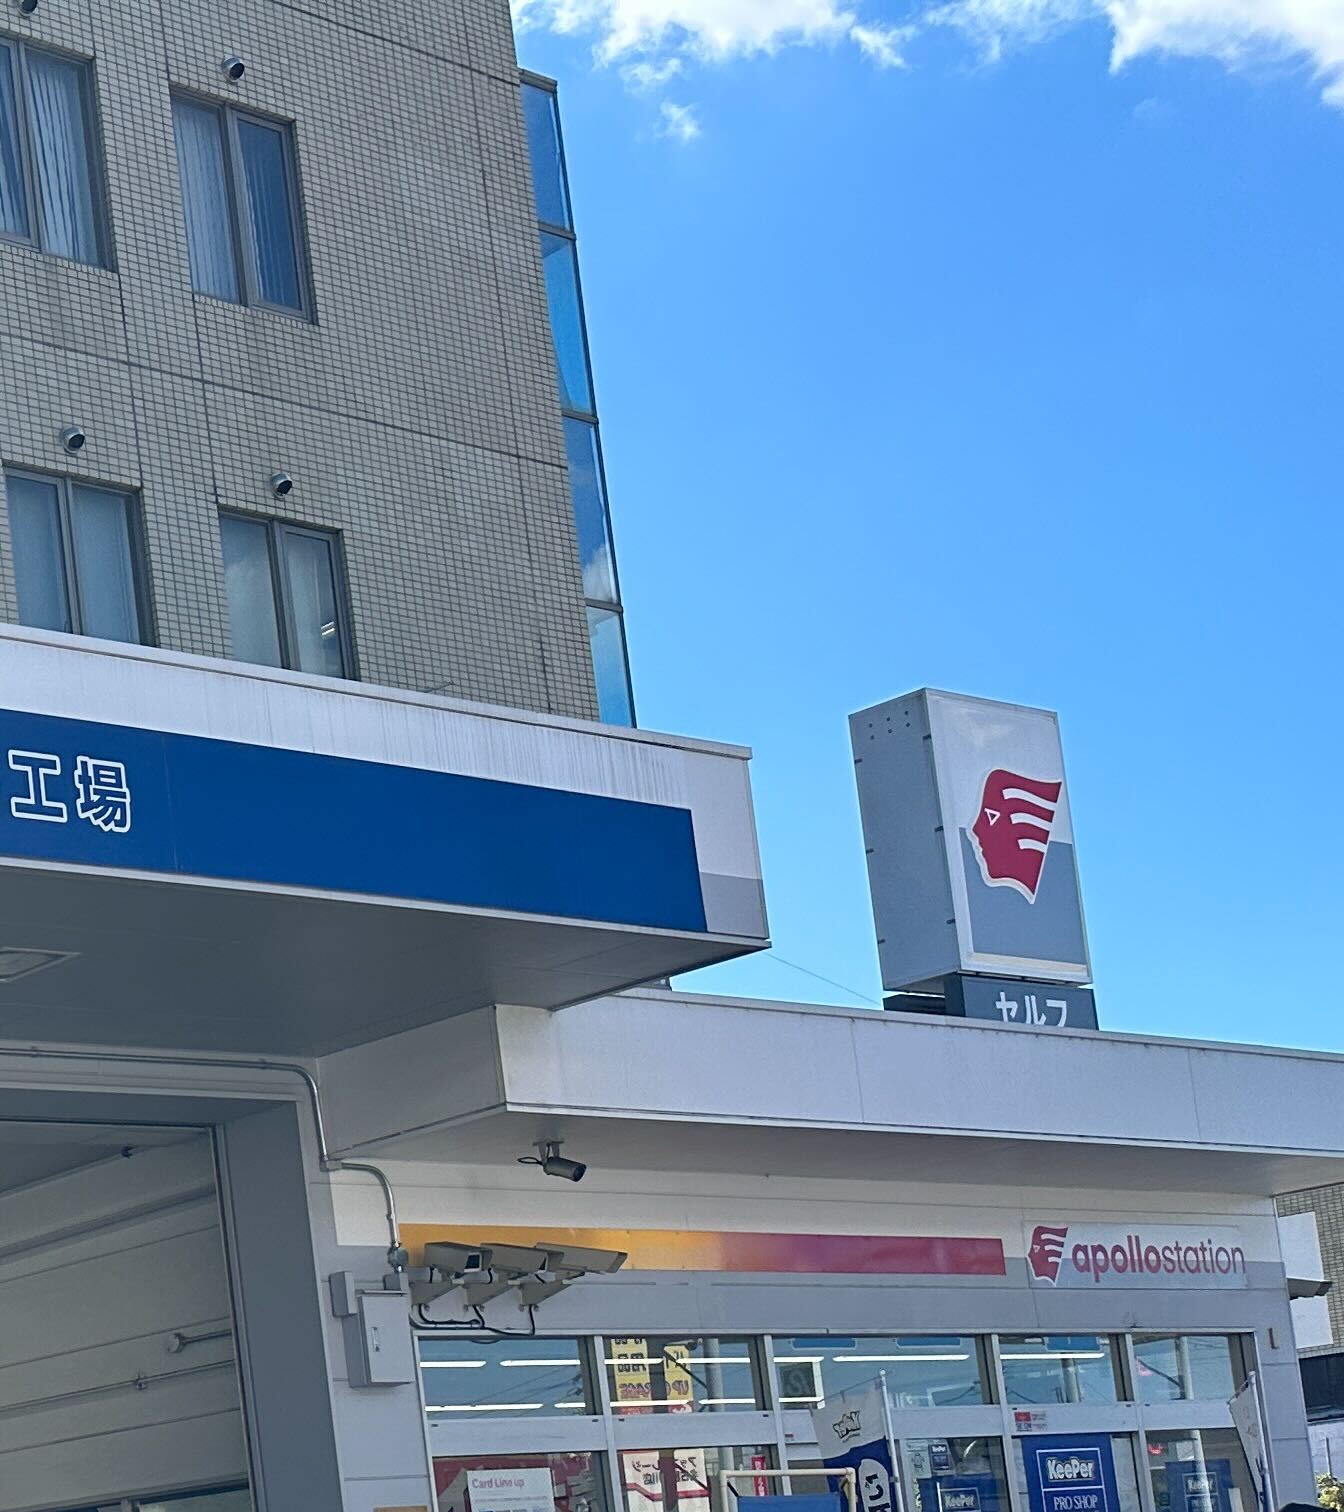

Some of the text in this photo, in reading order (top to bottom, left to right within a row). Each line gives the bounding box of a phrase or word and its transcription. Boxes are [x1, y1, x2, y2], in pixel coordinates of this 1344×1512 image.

[1072, 1235, 1246, 1284] apollostation
[1047, 1456, 1095, 1482] KeePer
[472, 1478, 493, 1489] Card
[1054, 1495, 1098, 1511] PRO SHOP
